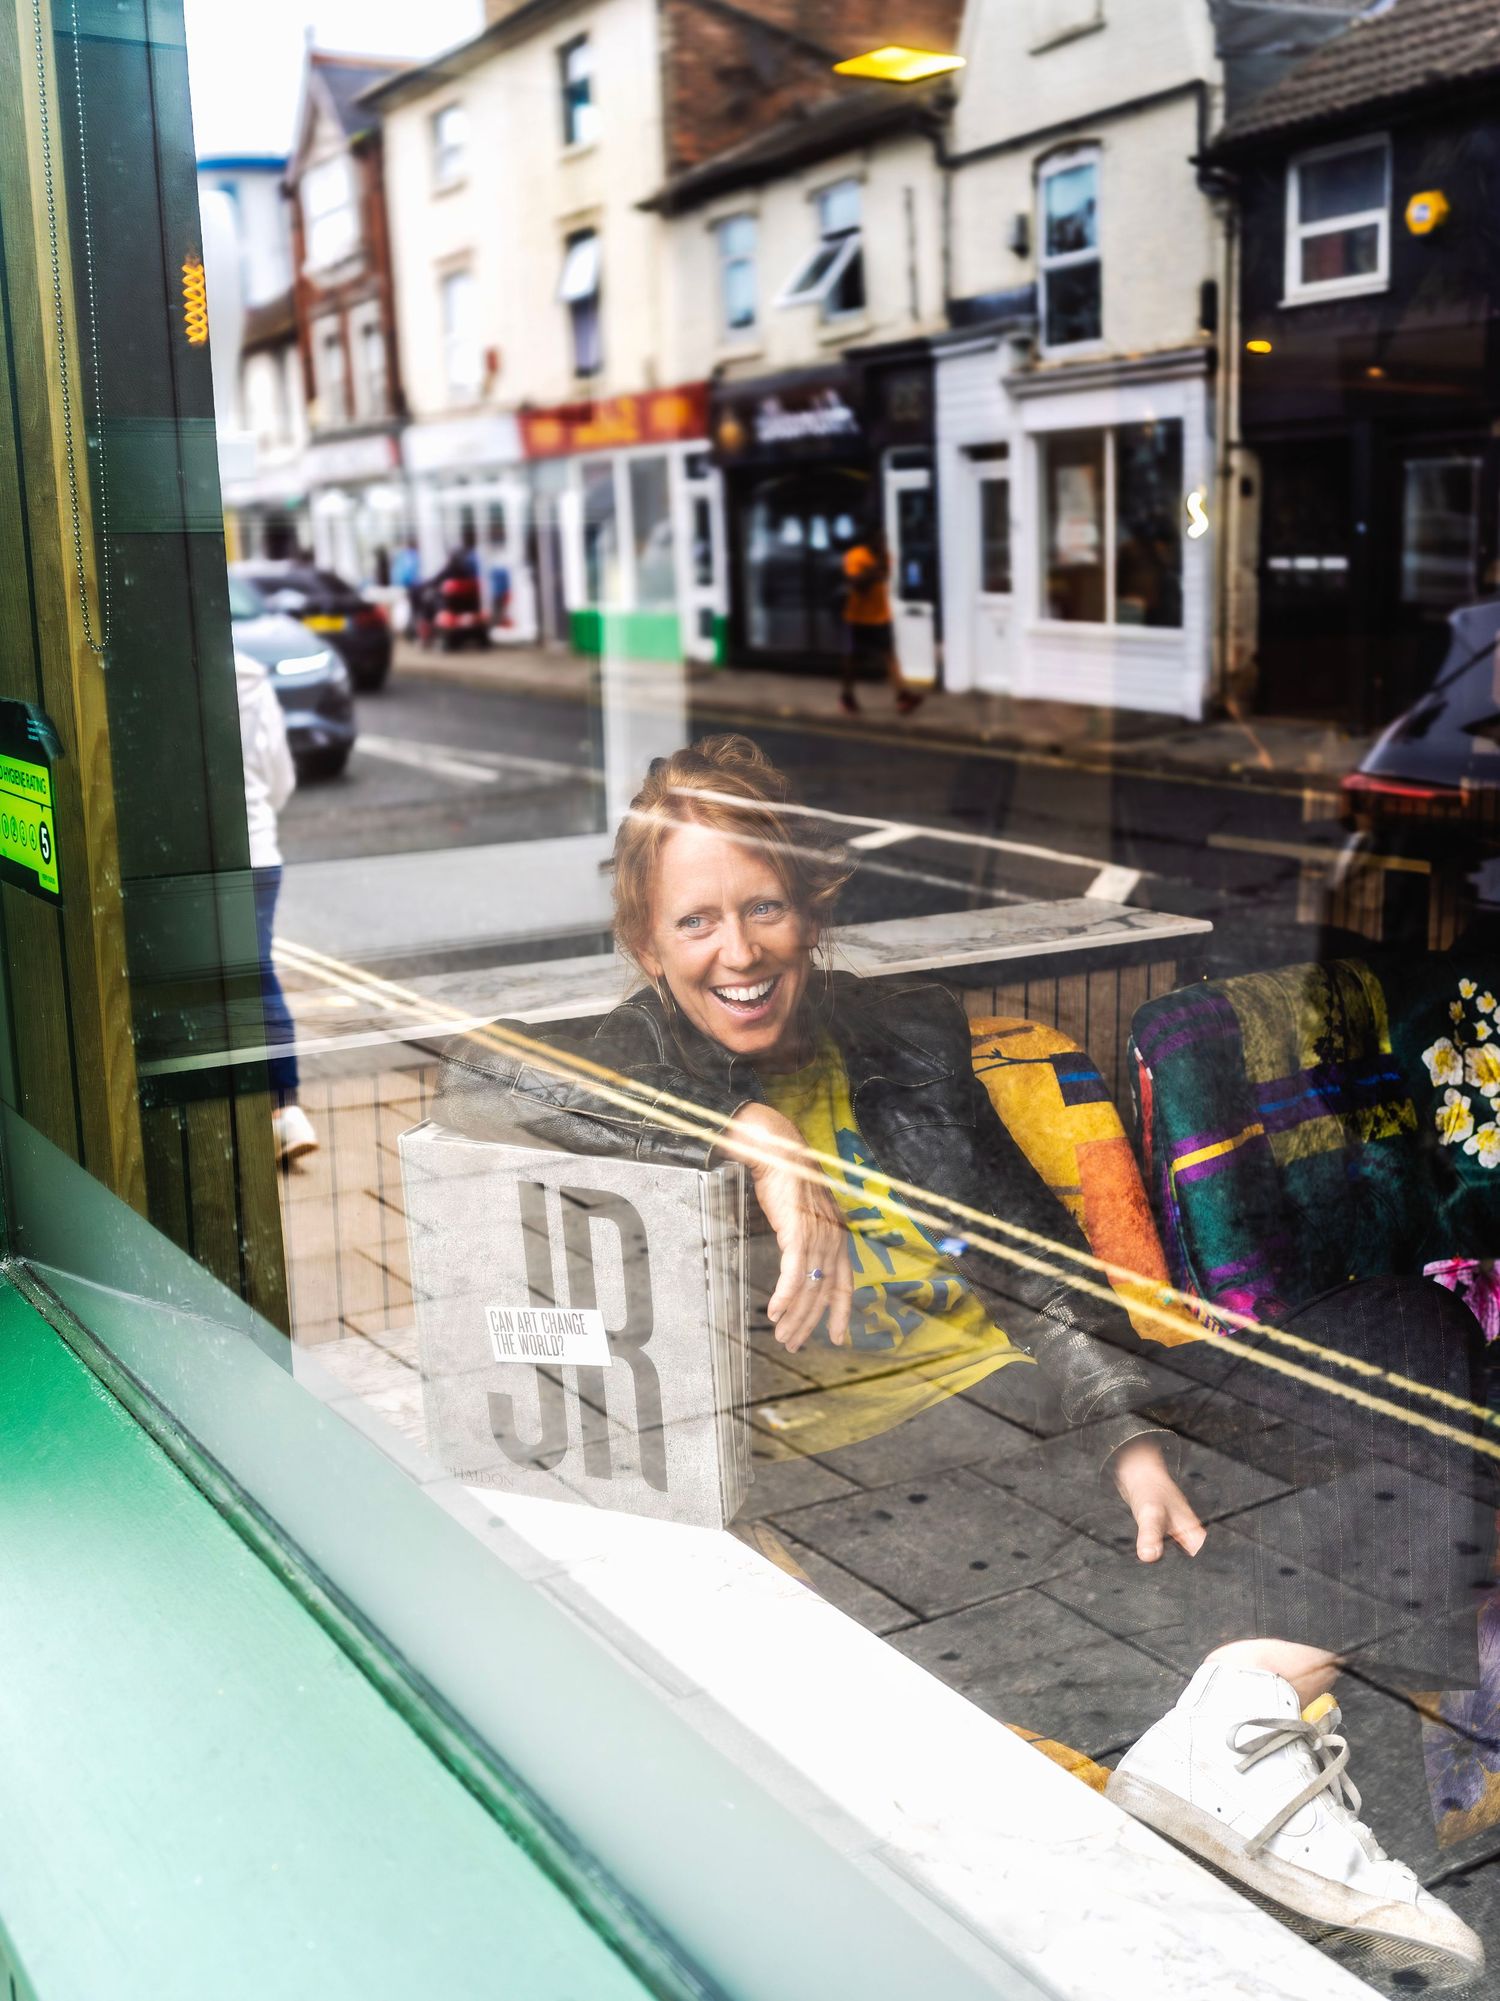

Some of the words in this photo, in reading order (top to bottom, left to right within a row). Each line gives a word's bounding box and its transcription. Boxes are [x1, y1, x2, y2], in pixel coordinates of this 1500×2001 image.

[26, 771, 47, 794] RATING
[40, 826, 50, 859] 5
[487, 1180, 668, 1492] JR
[489, 1310, 515, 1333] CAN
[517, 1311, 539, 1334] ART
[540, 1312, 589, 1336] CHANGE
[493, 1333, 517, 1355] THE
[518, 1334, 565, 1357] WORLD?
